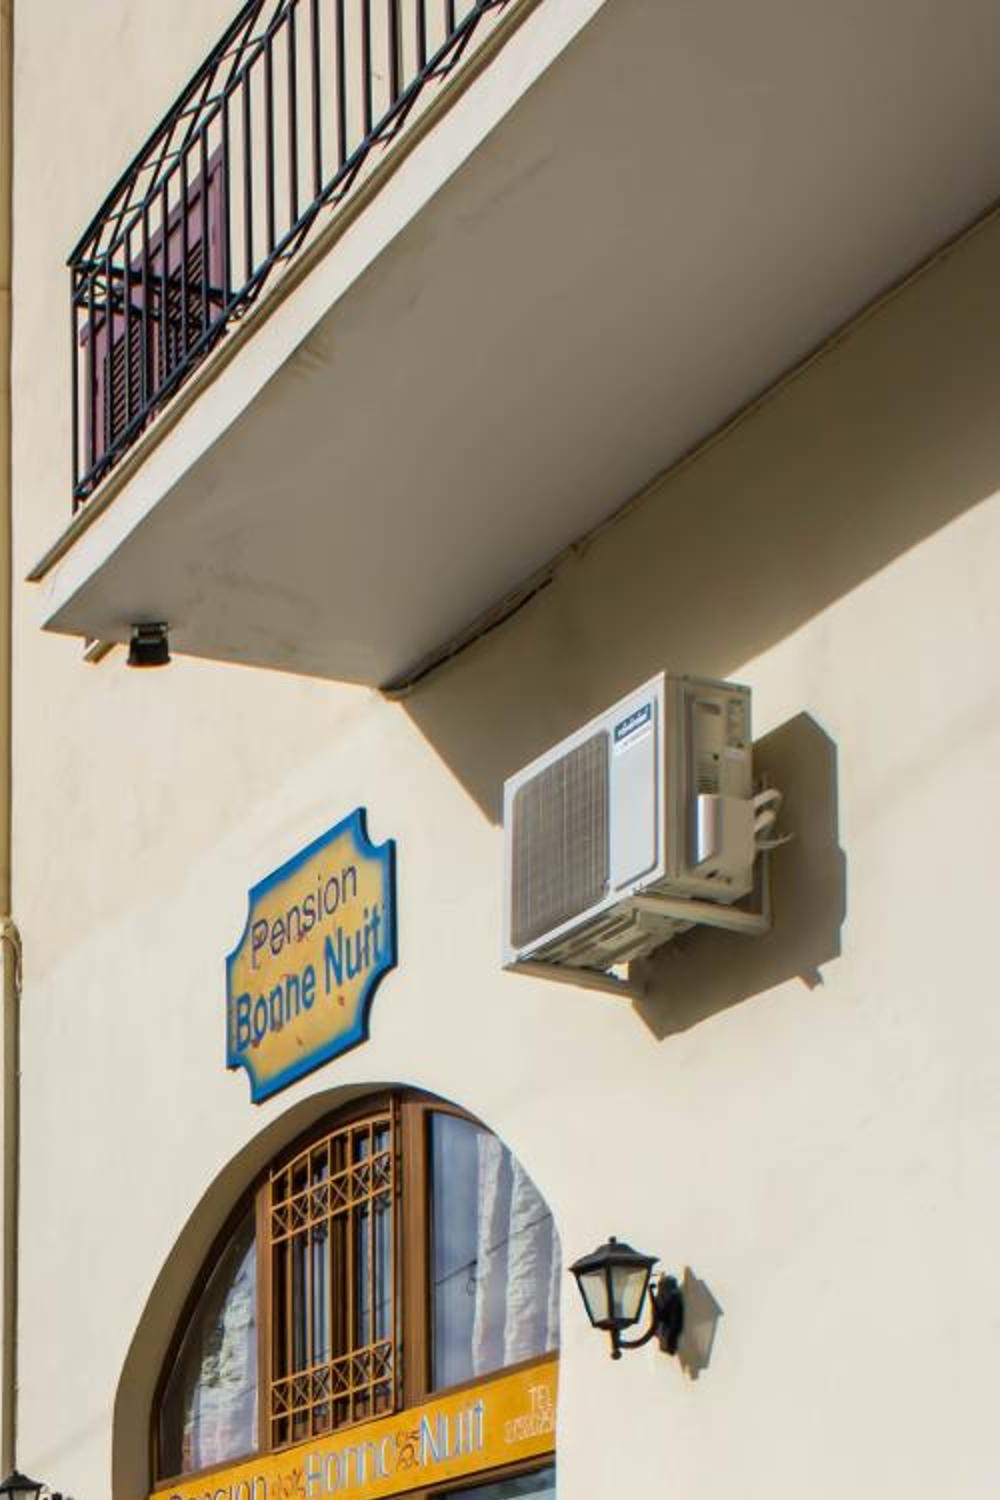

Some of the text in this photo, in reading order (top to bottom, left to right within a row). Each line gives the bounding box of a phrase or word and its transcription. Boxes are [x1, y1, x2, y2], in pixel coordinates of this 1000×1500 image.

[250, 864, 357, 970] Pension
[235, 902, 382, 1051] Bonne Nuit
[420, 1398, 484, 1467] Nuit
